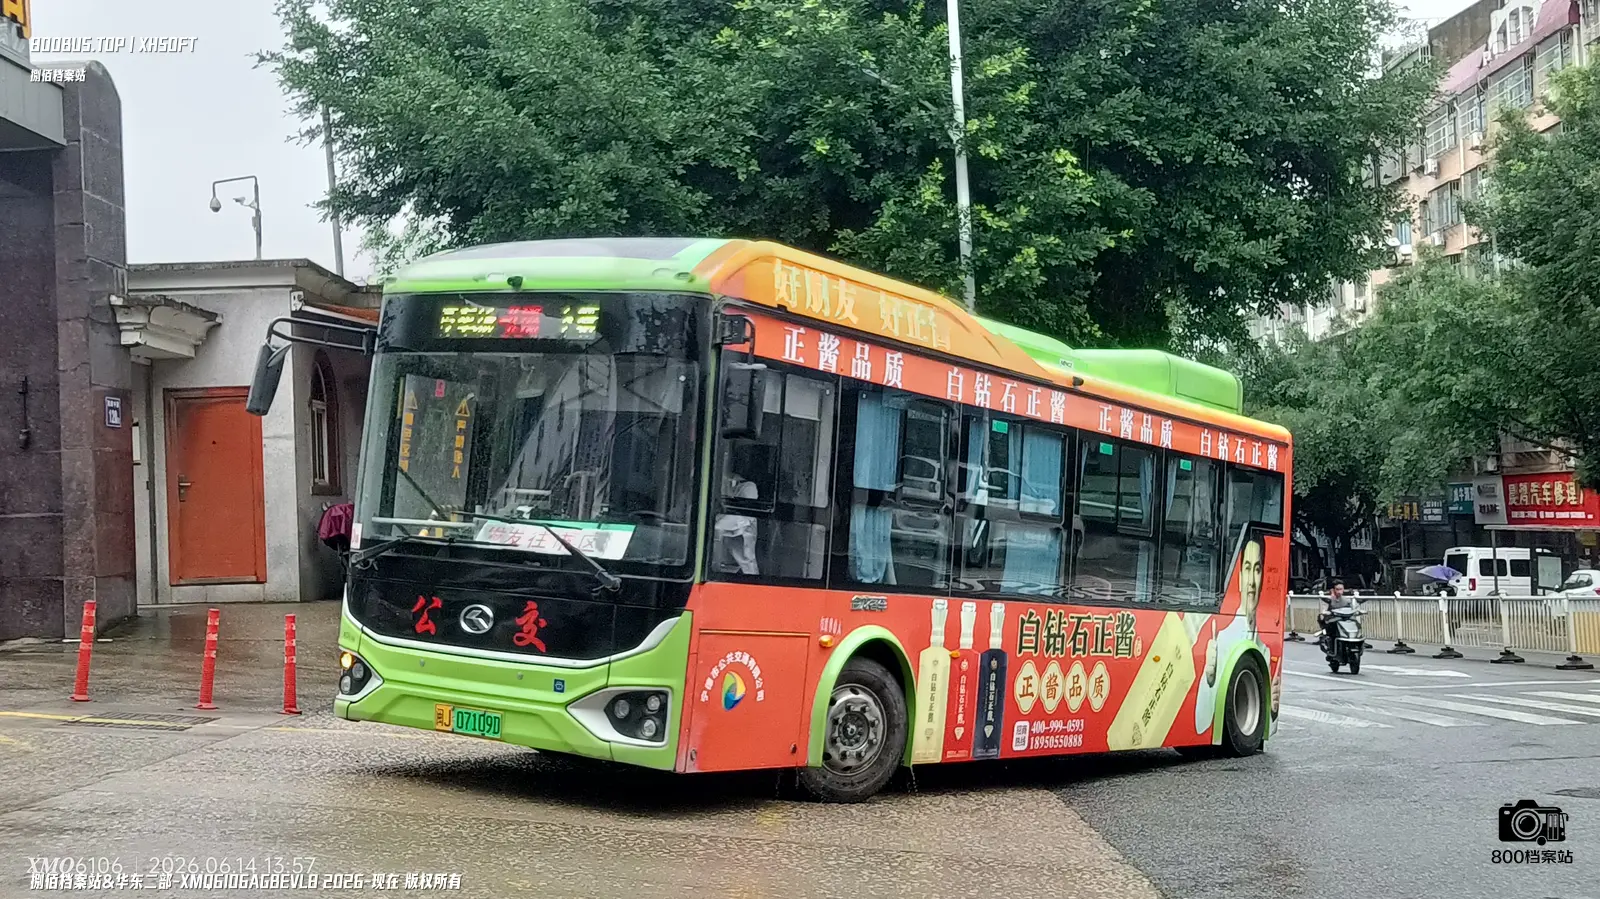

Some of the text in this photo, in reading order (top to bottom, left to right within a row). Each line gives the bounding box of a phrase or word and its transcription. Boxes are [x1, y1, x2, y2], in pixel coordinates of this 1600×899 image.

[773, 257, 859, 325] 好朋友
[782, 326, 1278, 471] 正酱品质 白钻石正酱 正酱品质 白钻石正酱
[411, 595, 548, 653] 公 交
[1017, 609, 1137, 659] 白钻石正酱
[1018, 673, 1105, 701] 正酱品质
[1029, 734, 1084, 750] 18950550888
[1030, 719, 1084, 734] 400-999-0593
